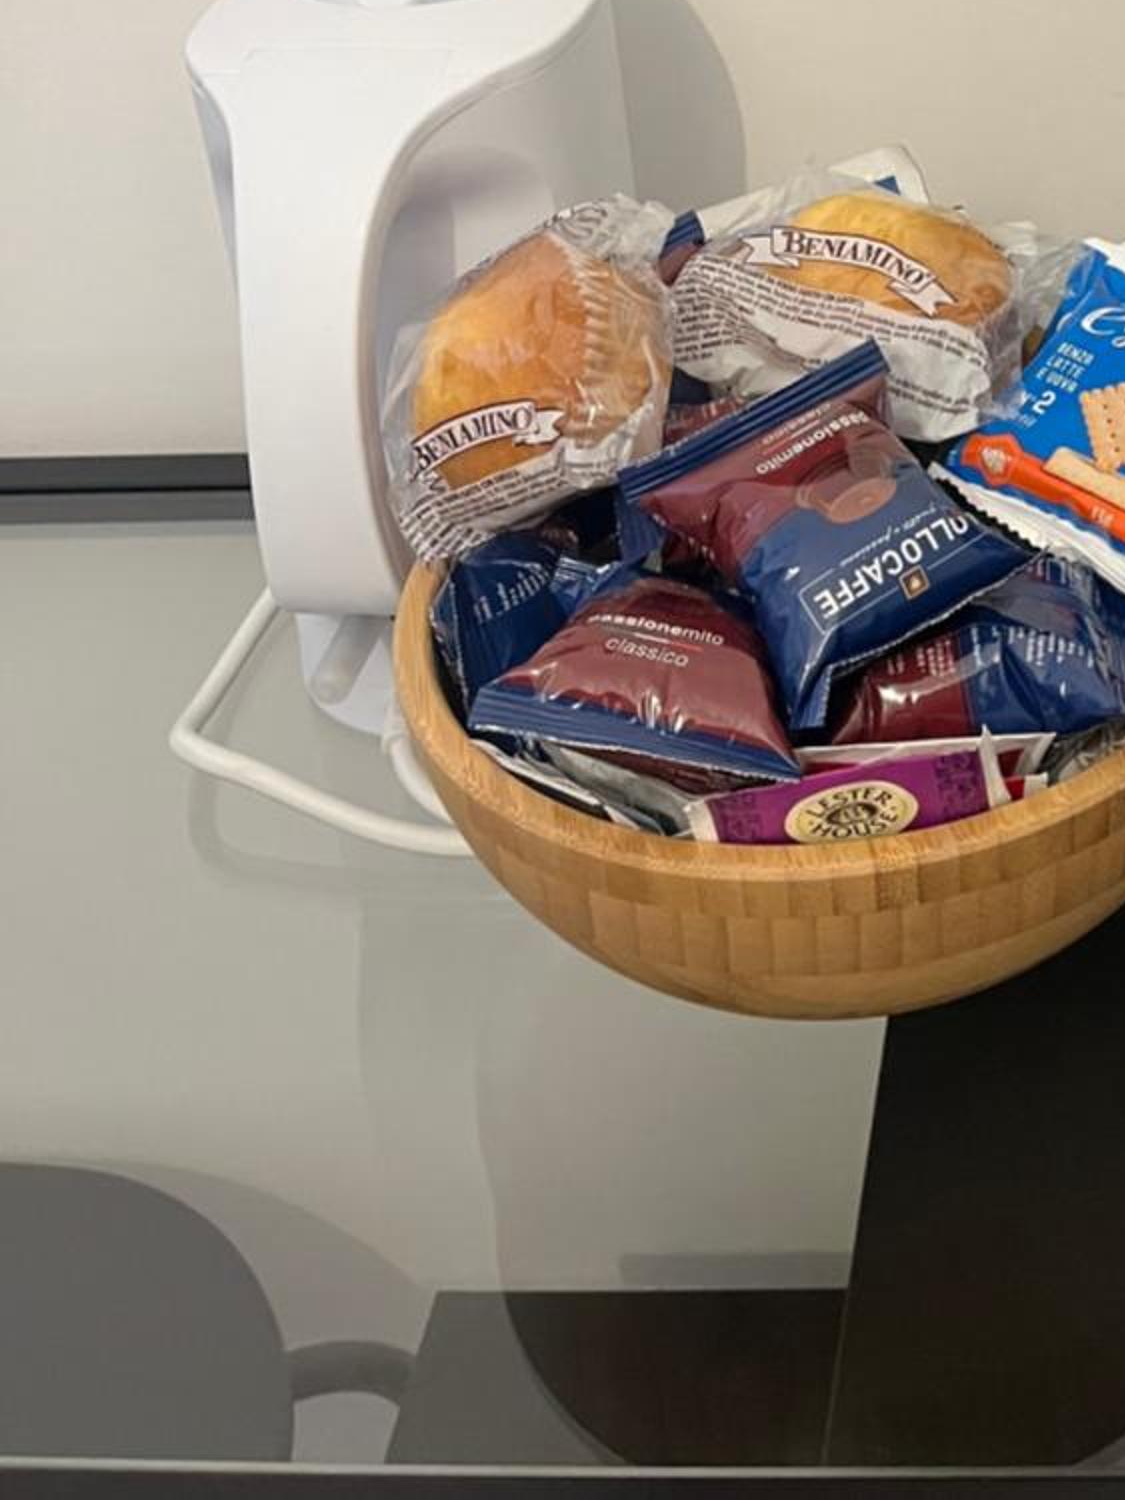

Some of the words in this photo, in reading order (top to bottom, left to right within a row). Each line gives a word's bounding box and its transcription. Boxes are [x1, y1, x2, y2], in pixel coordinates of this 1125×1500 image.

[604, 636, 690, 668] classico
[806, 786, 893, 817] LESTER
[810, 812, 898, 839] HOUSE
